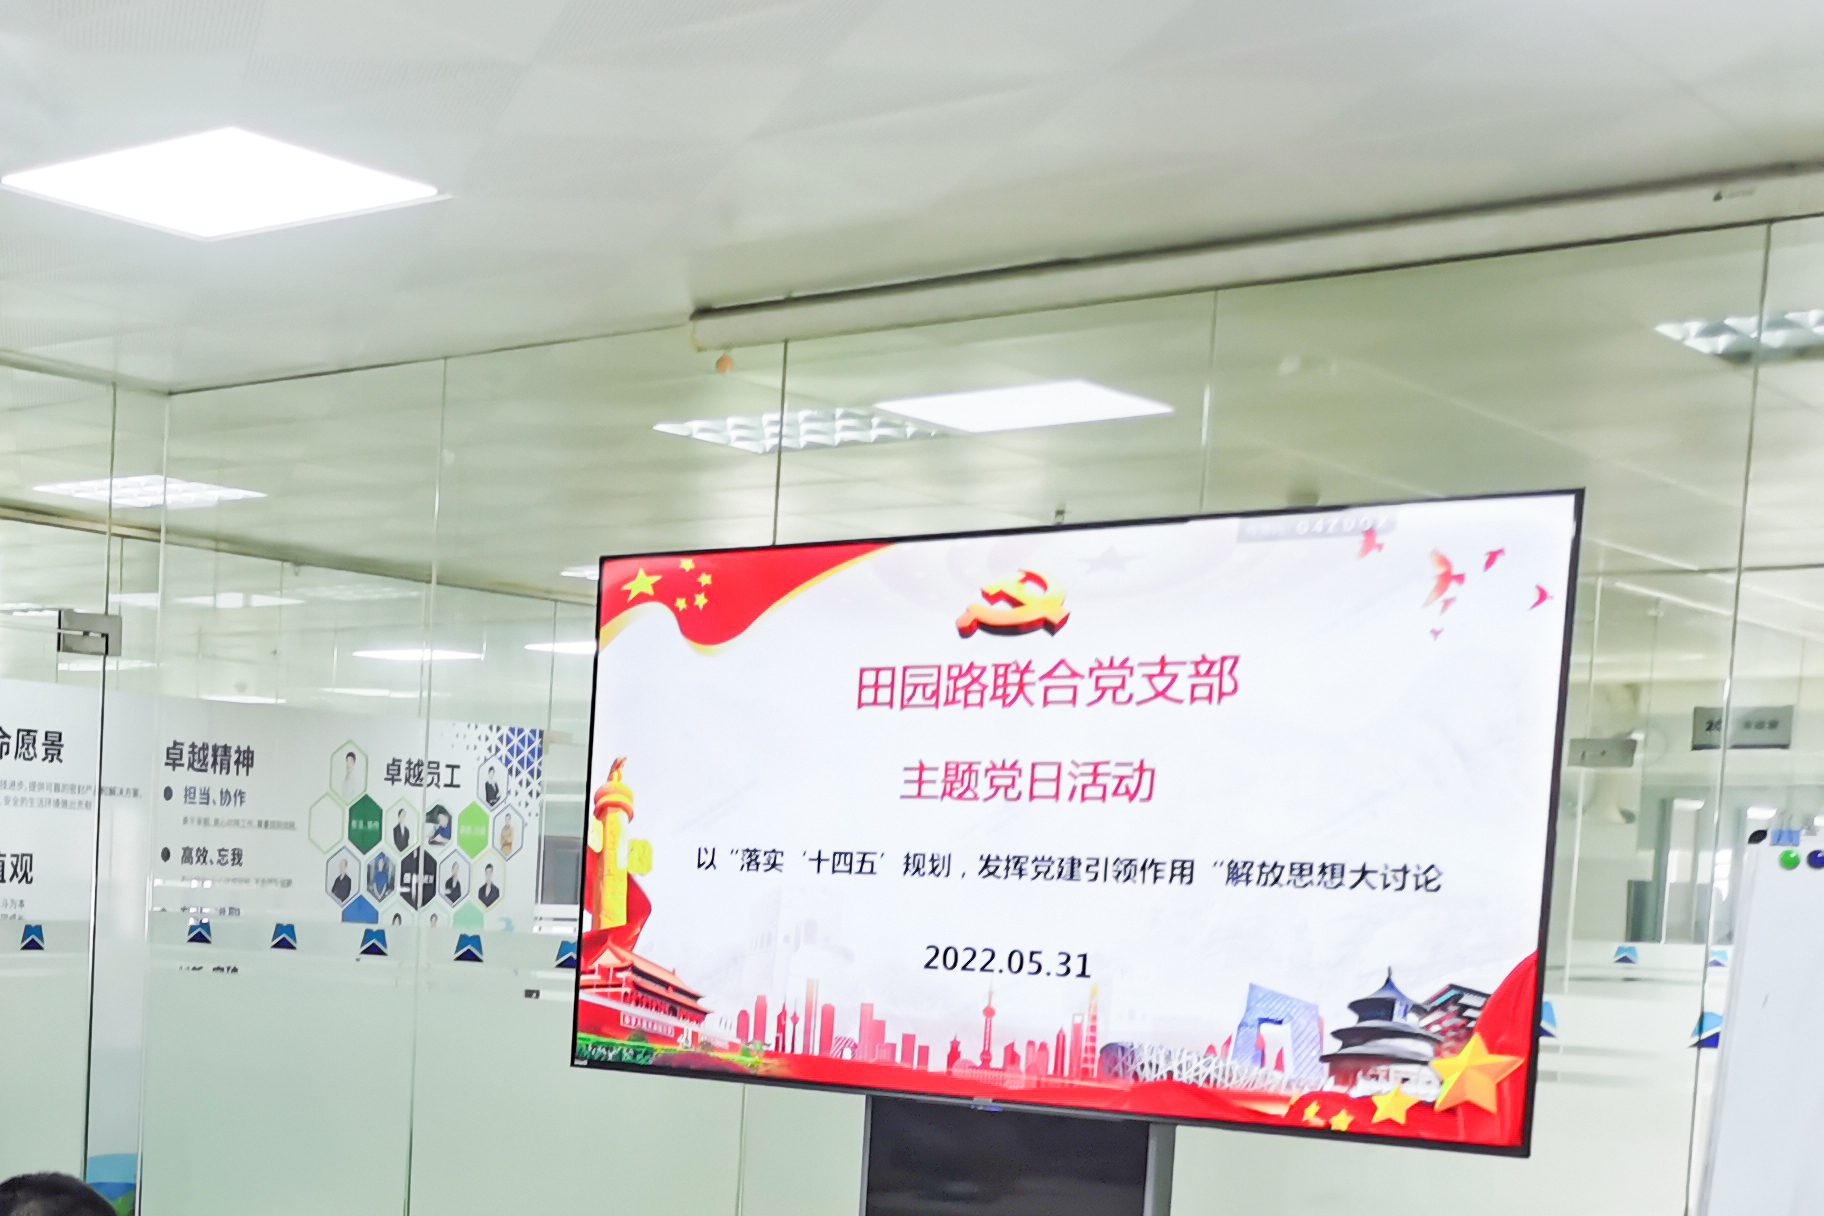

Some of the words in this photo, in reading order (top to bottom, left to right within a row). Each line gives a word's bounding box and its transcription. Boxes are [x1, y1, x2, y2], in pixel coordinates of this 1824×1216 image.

[856, 654, 1241, 711] 田园路联合党支部
[163, 739, 255, 777] 卓越精神
[383, 756, 462, 789] 卓越员工
[183, 785, 247, 807] 担当、协作
[899, 758, 1157, 804] 主题党日活动
[181, 845, 244, 867] 高效、忘我
[923, 945, 1091, 979] 2022.05.31
